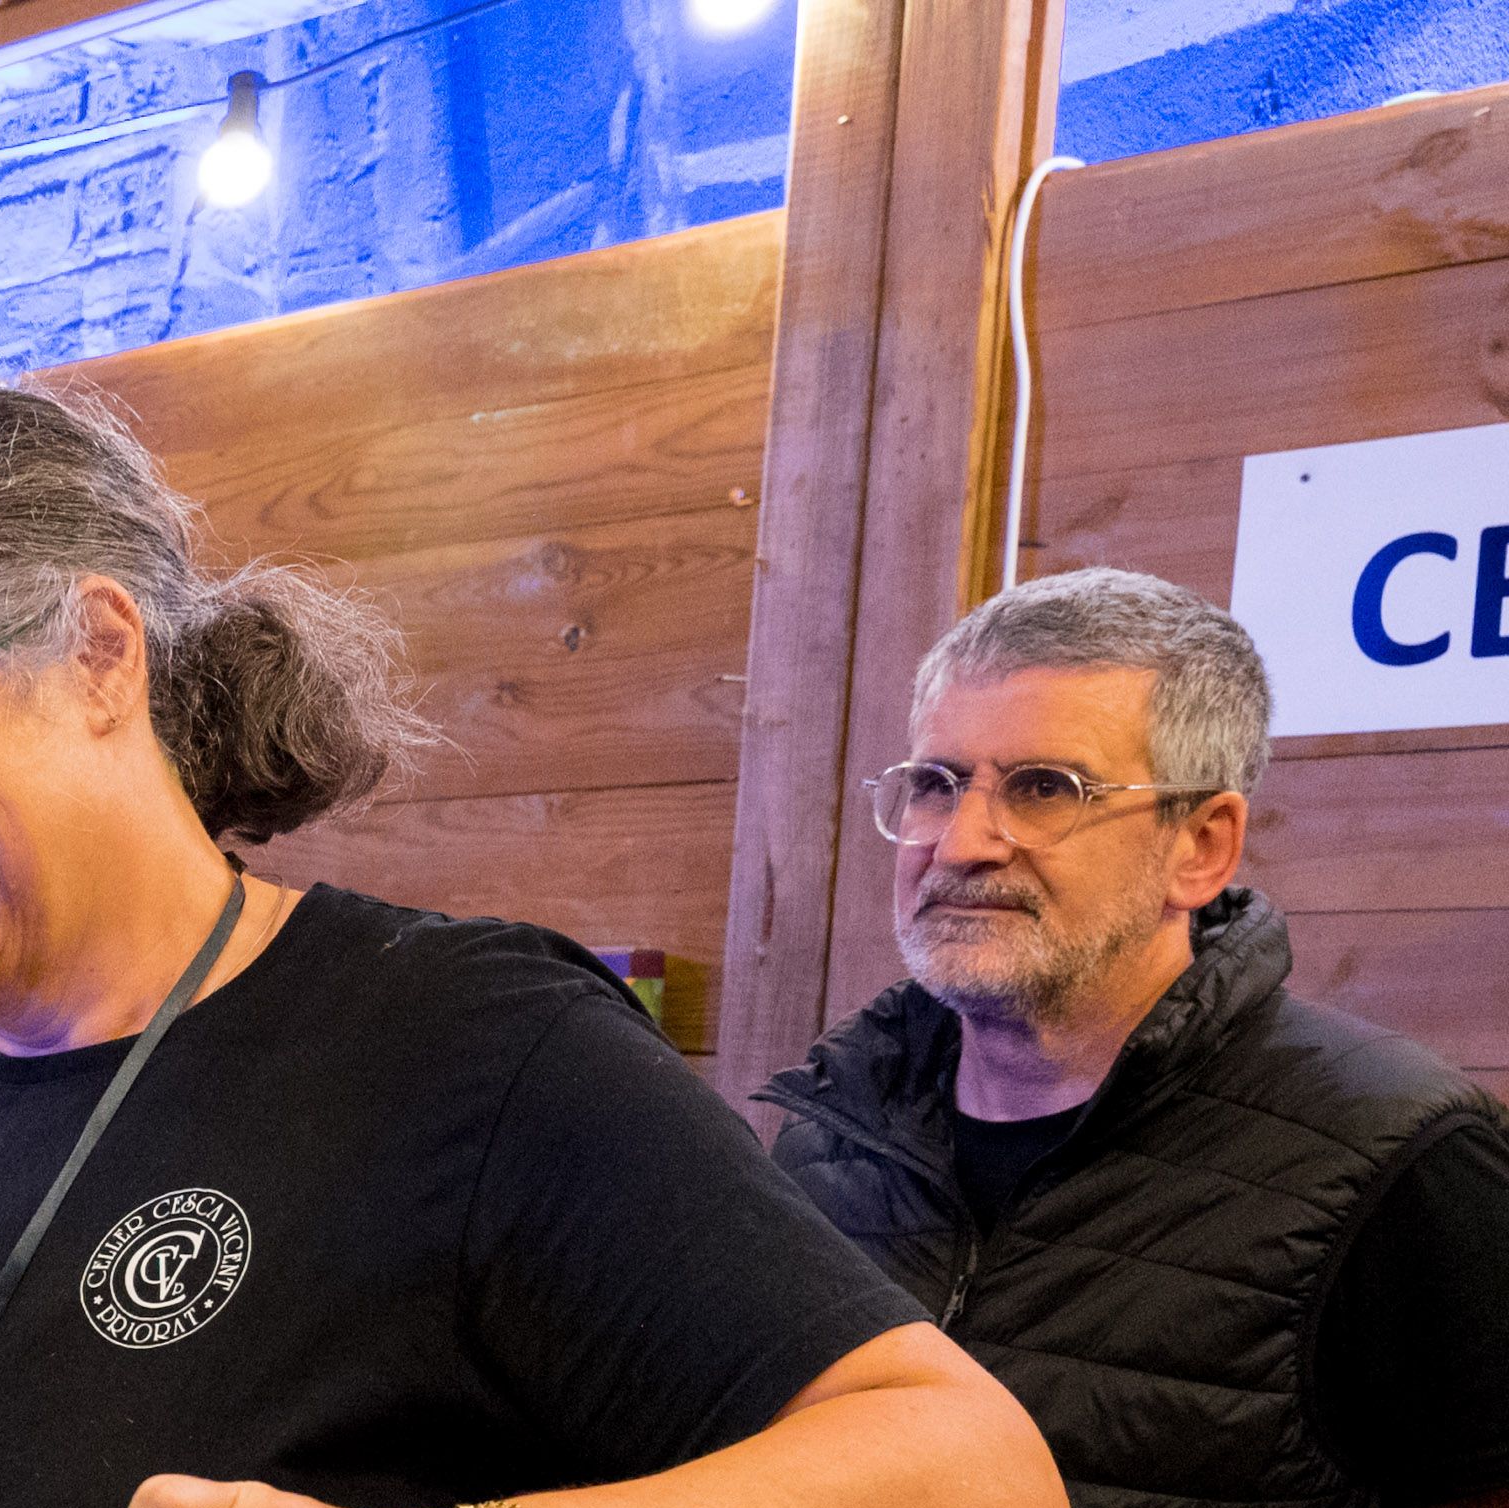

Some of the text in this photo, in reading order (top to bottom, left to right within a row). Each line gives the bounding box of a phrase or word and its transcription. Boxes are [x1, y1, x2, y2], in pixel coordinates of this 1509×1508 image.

[86, 1193, 245, 1292] CELLER CESCA VICENT
[96, 1304, 199, 1344] PRIORAT
